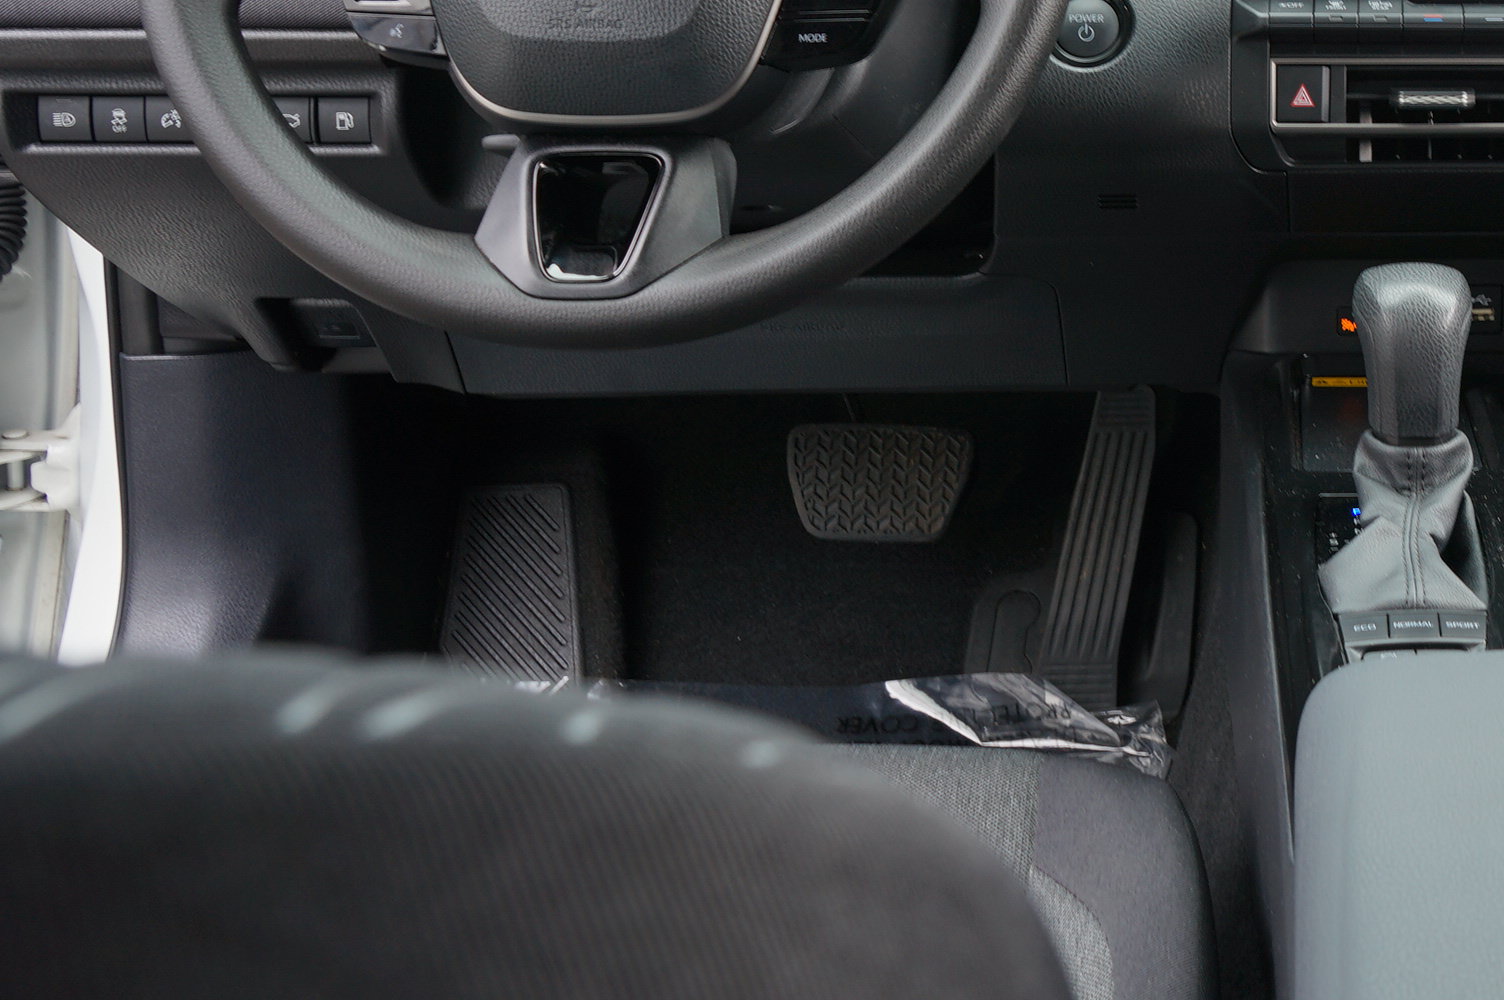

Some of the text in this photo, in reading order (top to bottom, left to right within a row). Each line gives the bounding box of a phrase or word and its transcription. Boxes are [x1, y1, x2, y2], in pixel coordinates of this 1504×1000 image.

[1068, 13, 1105, 24] POWER
[797, 32, 829, 44] MODE
[1353, 623, 1377, 633] ECO
[1393, 620, 1434, 630] NORMAL
[1445, 620, 1481, 630] SPORT
[837, 715, 919, 734] COVER
